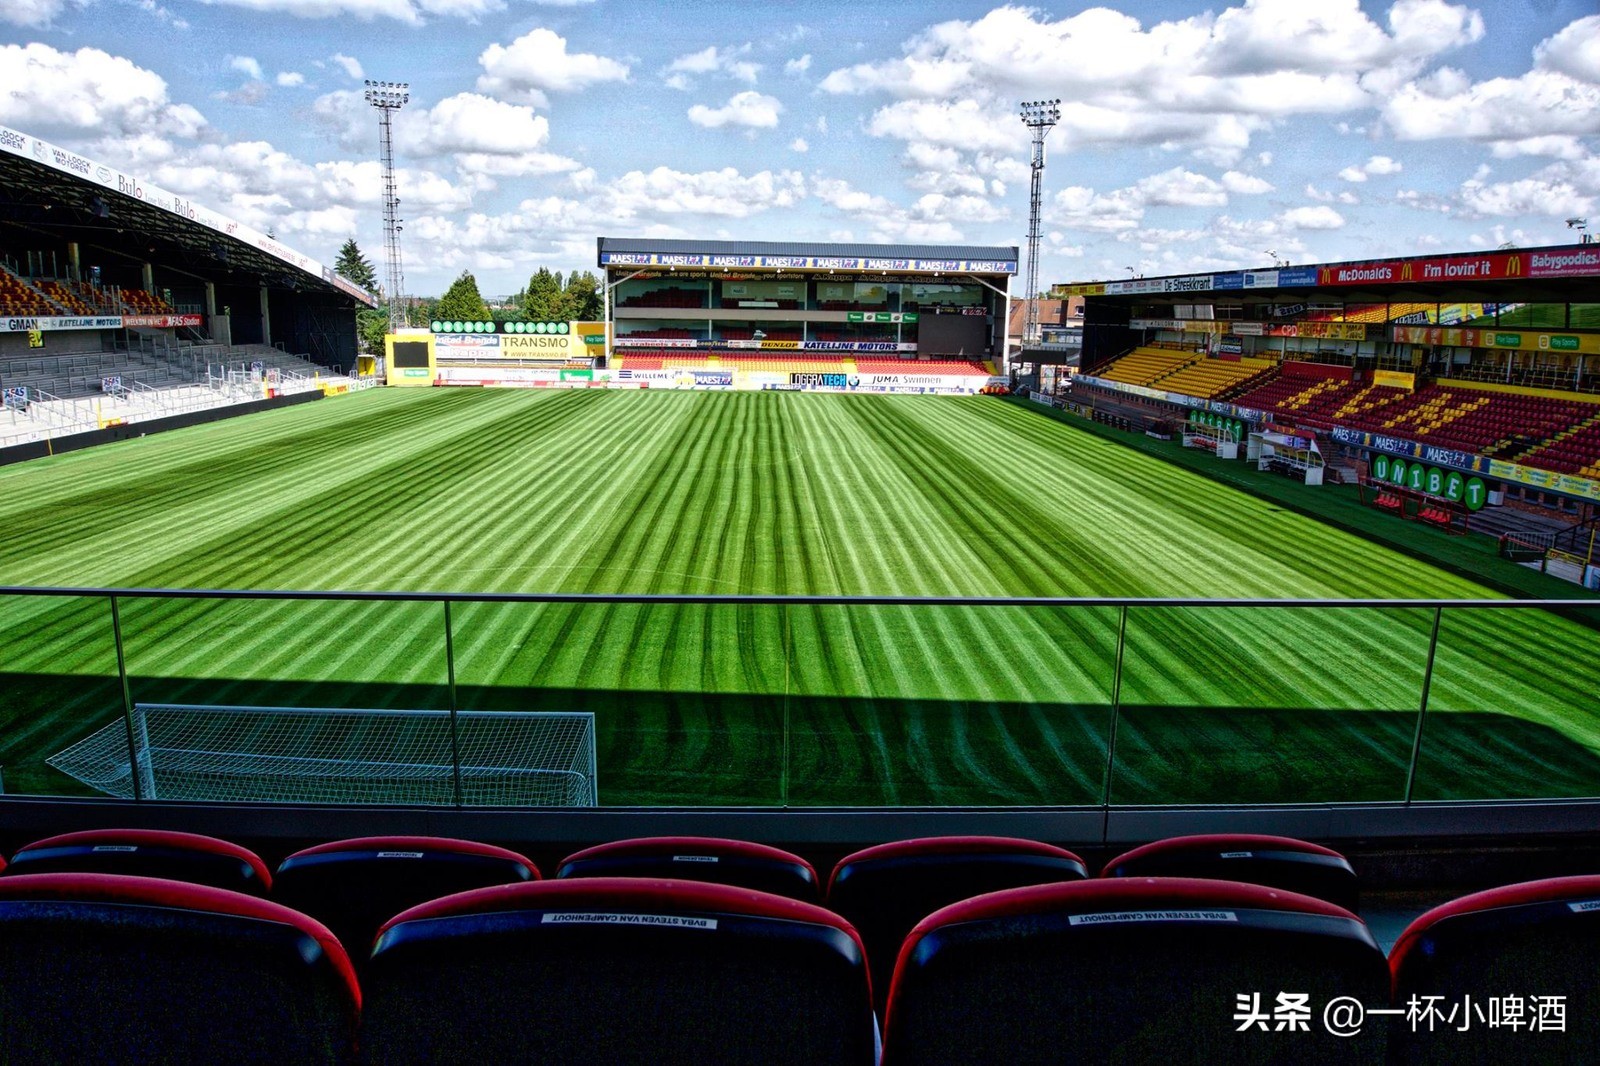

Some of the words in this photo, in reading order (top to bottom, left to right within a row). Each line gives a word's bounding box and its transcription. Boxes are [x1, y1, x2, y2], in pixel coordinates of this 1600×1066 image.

[52, 149, 67, 159] VAN
[68, 154, 91, 169] LOOCK
[55, 157, 89, 174] MOTOREN
[118, 174, 142, 199] Bulo
[175, 198, 195, 219] Bulo
[1338, 267, 1392, 282] McDonald's
[1424, 263, 1441, 278] i'm
[1481, 261, 1491, 275] it
[1164, 280, 1172, 292] De
[1174, 276, 1211, 292] Streekkrant
[168, 316, 183, 326] AFAS
[502, 337, 569, 348] TRANSMO
[804, 341, 855, 350] KATELIJNE
[858, 342, 898, 351] MOTORS
[872, 375, 899, 384] JUMA
[904, 375, 942, 384] Swinnen
[1332, 427, 1350, 441] MAES
[1375, 437, 1394, 451] MAES
[1427, 448, 1449, 464] MAES
[1377, 461, 1482, 504] UNIBET
[552, 914, 617, 922] CAMPENHOUT
[620, 915, 639, 923] VAN
[642, 916, 679, 925] STEVEN
[1079, 913, 1143, 922] CAMPENHOUT
[1165, 911, 1201, 919] STEVEN
[682, 918, 707, 927] BVBA
